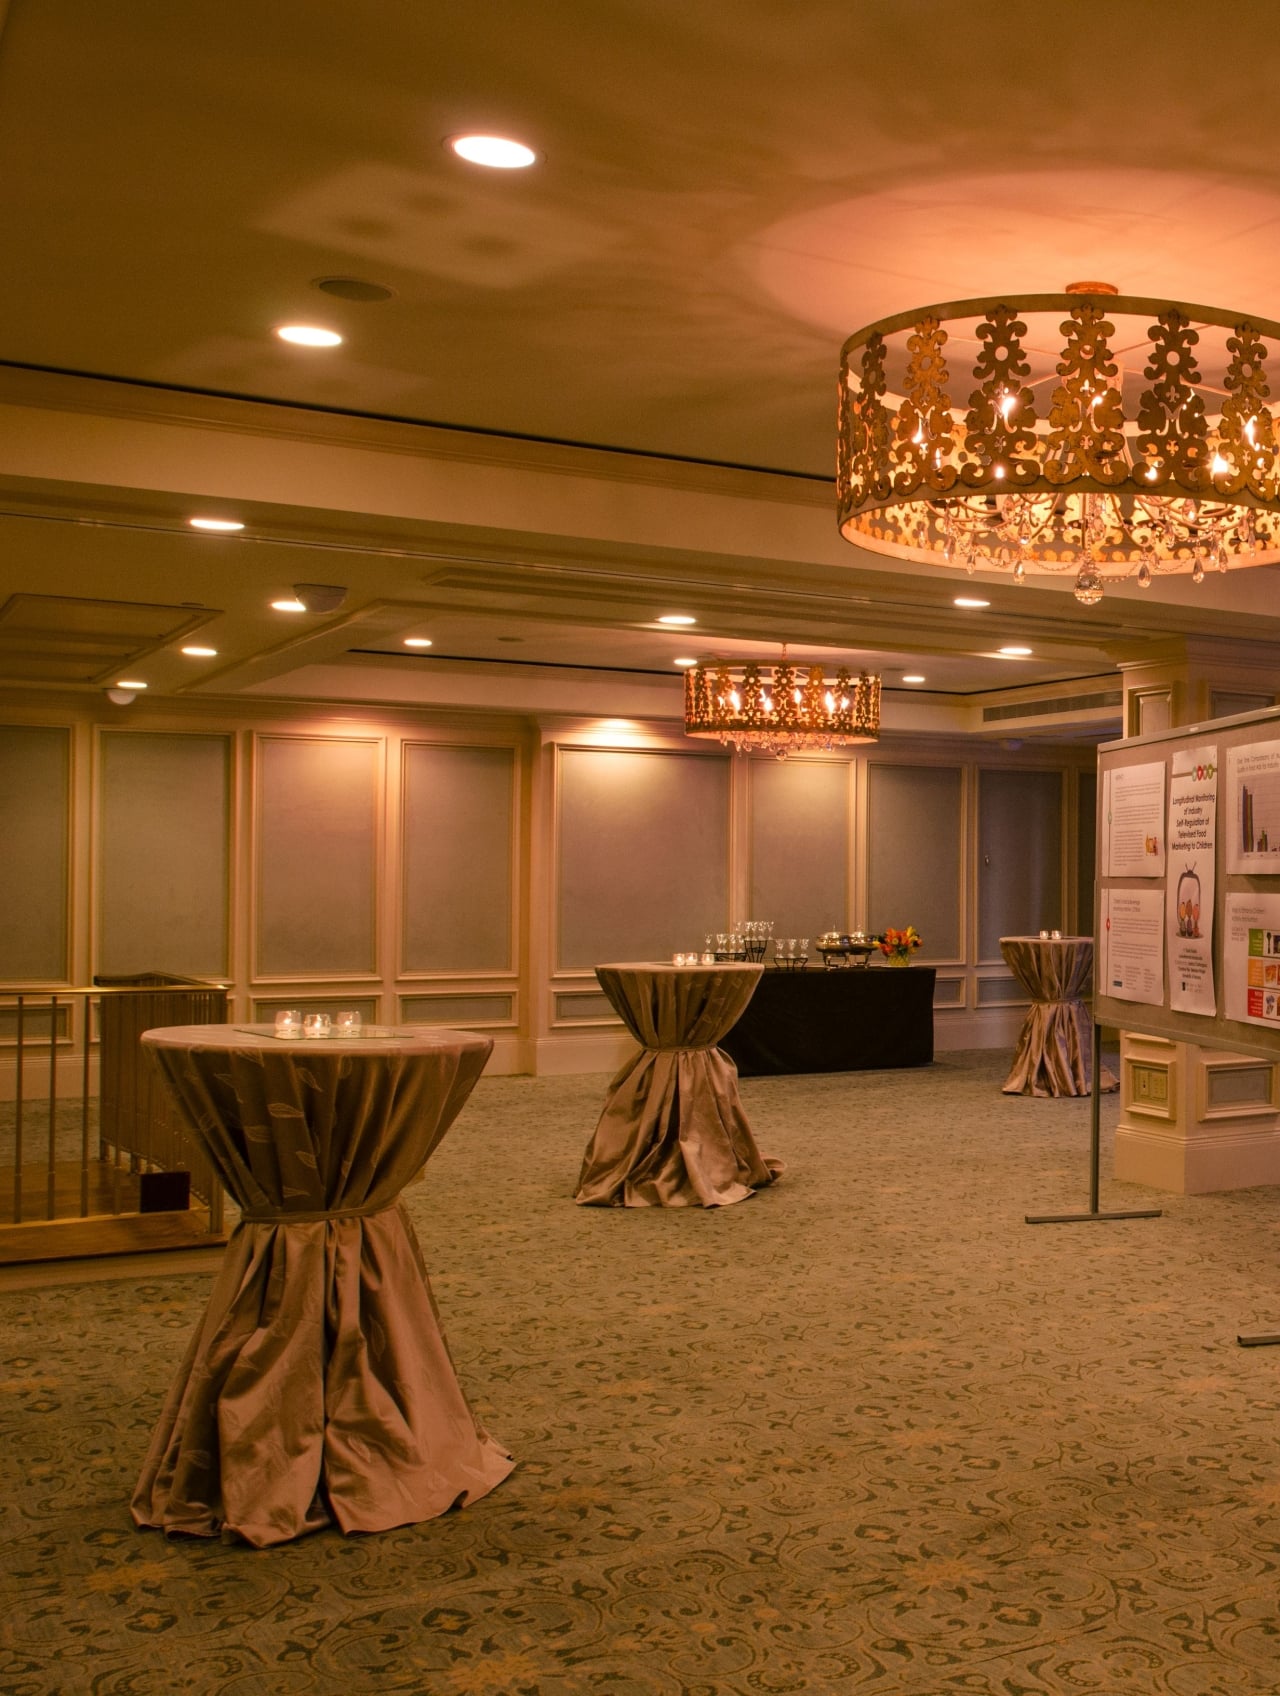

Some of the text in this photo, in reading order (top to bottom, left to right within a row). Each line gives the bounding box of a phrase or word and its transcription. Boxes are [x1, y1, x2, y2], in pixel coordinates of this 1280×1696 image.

[1172, 793, 1215, 806] Longitudinal Monitoring
[1188, 806, 1203, 815] Industry
[1178, 829, 1207, 839] Televised Food
[1171, 842, 1191, 852] Marketing
[1196, 841, 1213, 850] Children
